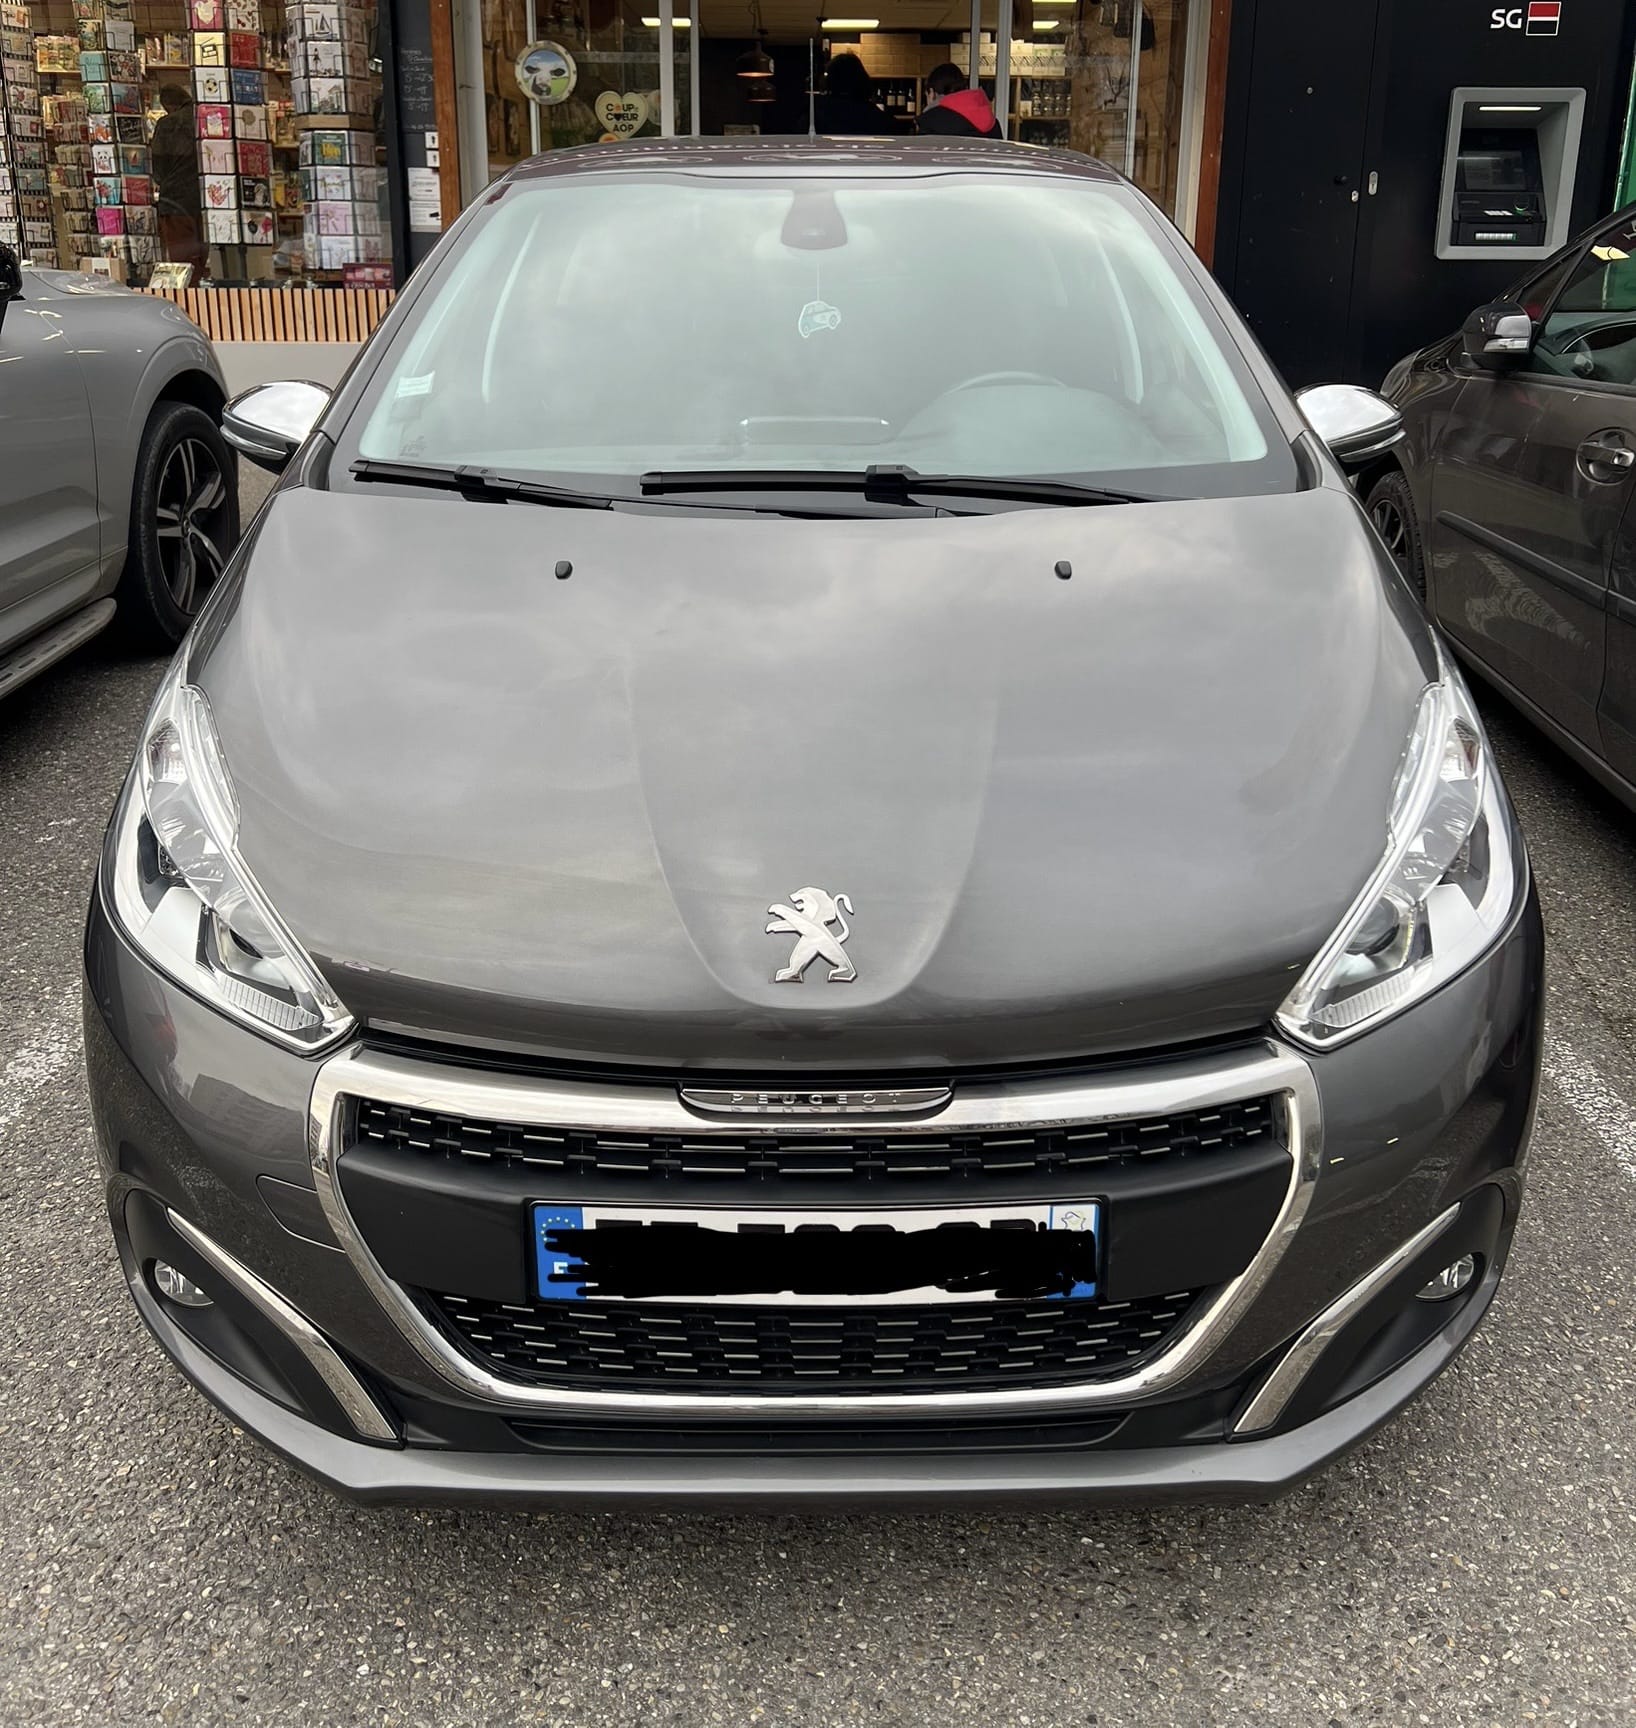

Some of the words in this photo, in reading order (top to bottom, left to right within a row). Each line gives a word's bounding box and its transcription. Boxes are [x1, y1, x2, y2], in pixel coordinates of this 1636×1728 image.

[1490, 8, 1522, 29] SG
[613, 123, 634, 132] AOP
[730, 1092, 902, 1105] PEUGEOT
